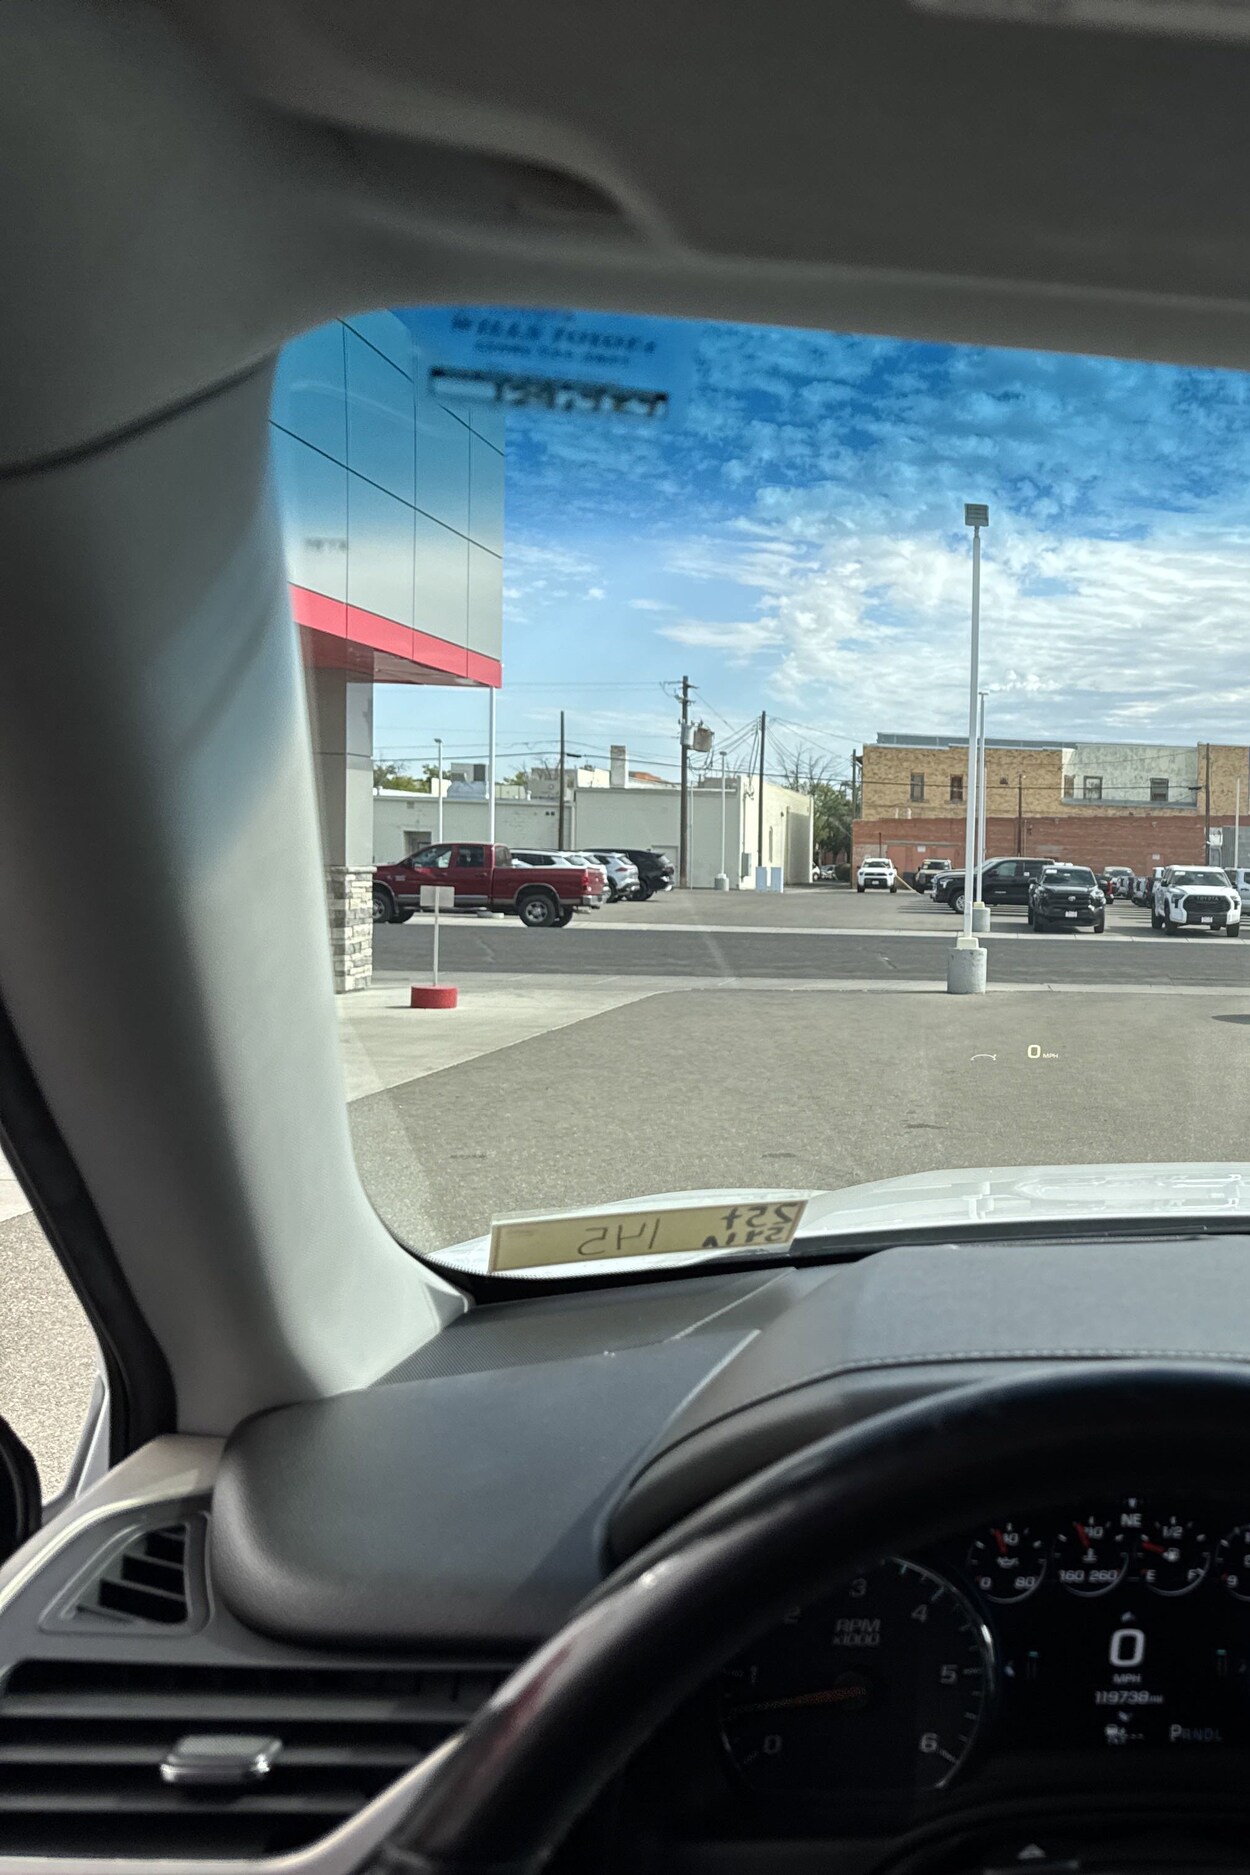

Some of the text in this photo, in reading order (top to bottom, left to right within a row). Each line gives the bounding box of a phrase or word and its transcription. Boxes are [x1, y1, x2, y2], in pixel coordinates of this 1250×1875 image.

[1027, 1044, 1041, 1058] 0
[1120, 1513, 1142, 1527] NE
[1162, 1525, 1183, 1538] 1/2
[1014, 1577, 1036, 1589] 80
[1060, 1570, 1118, 1582] 160 260
[1146, 1570, 1156, 1582] E
[1226, 1576, 1238, 1588] 9
[849, 1578, 867, 1598] 3
[911, 1604, 929, 1623] 4
[835, 1618, 880, 1632] RPM
[1109, 1628, 1145, 1667] 0
[940, 1664, 958, 1685] 5
[1113, 1673, 1142, 1684] MPH
[919, 1732, 938, 1753] 6
